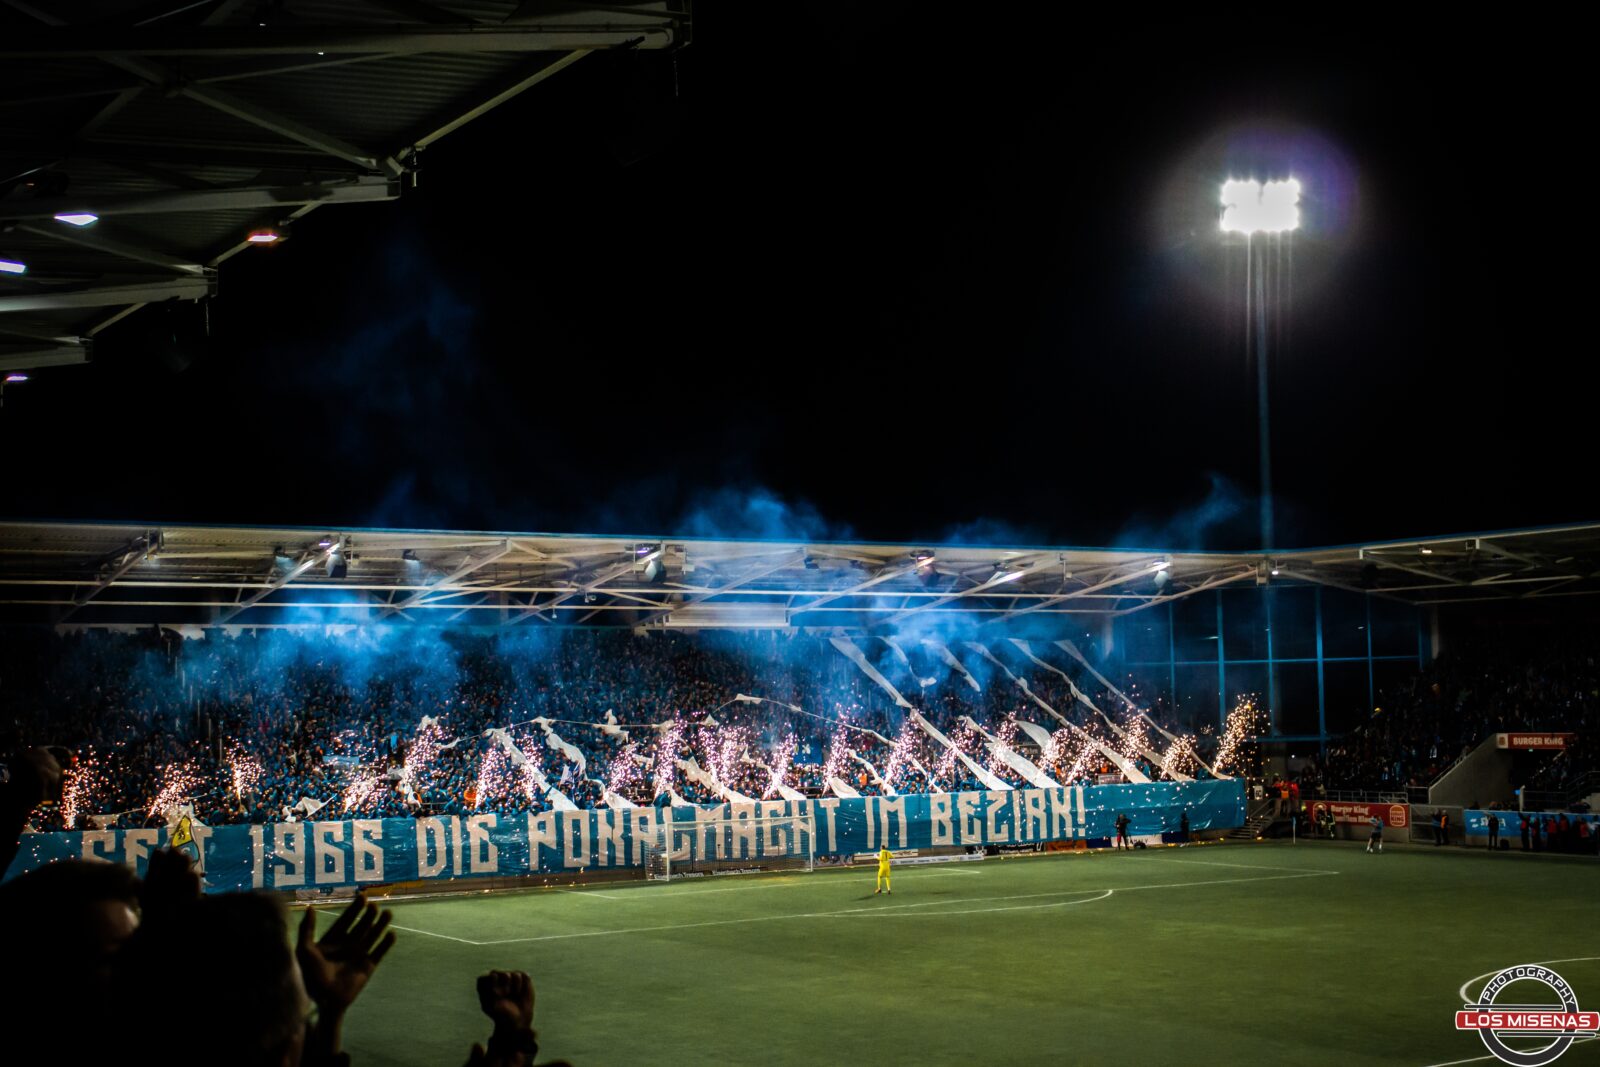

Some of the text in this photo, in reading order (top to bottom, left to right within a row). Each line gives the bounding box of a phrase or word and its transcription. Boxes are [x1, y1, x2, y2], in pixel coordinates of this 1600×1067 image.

[1512, 736, 1543, 746] BURGER
[248, 818, 385, 889] 1966
[864, 795, 908, 849] IM
[929, 786, 1087, 846] BEZIRK!
